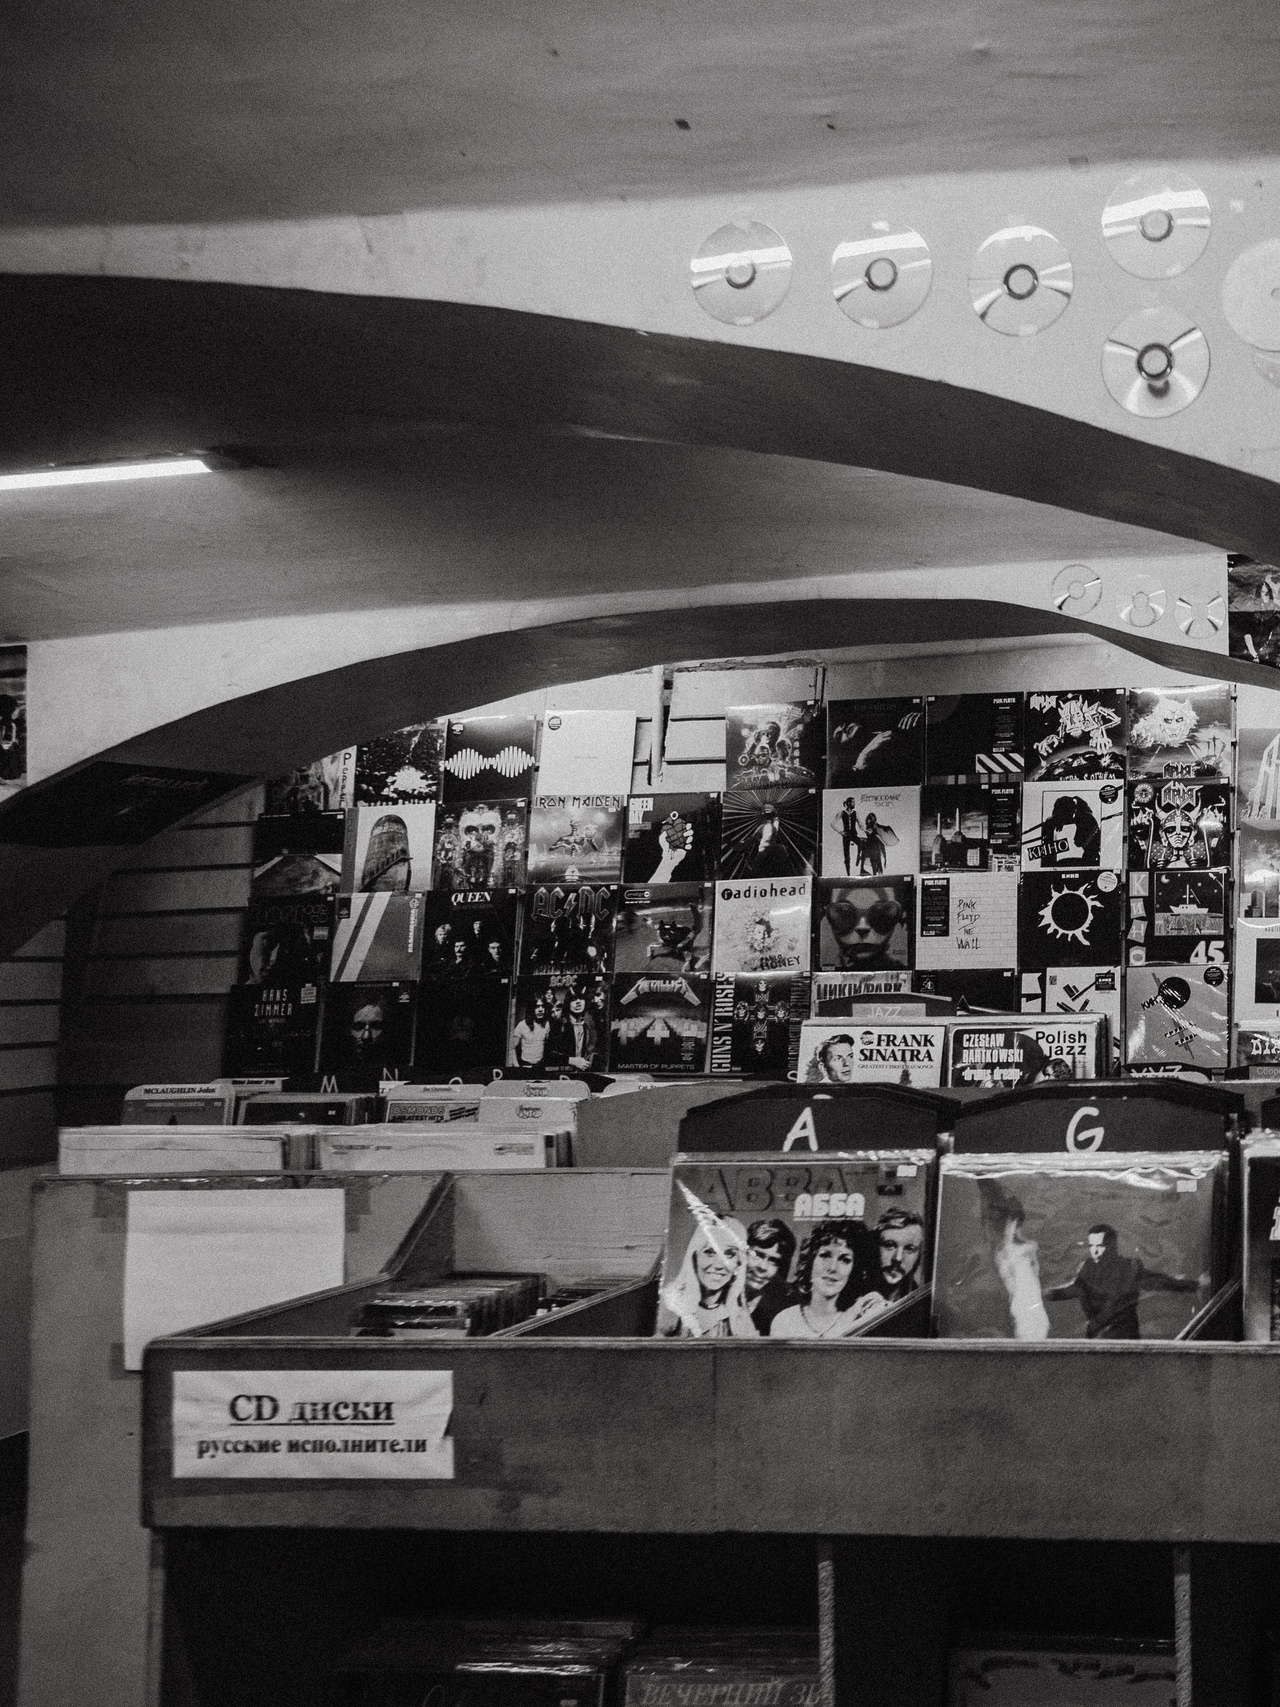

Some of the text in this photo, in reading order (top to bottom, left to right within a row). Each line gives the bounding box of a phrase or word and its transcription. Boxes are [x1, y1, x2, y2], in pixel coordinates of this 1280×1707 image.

[534, 795, 622, 809] IRON MAIDEN
[1028, 839, 1069, 861] КИНО
[451, 891, 493, 905] QUEEN
[721, 883, 806, 900] radiohead
[957, 899, 976, 910] PINK
[956, 937, 981, 950] WALL
[1189, 940, 1225, 963] 45
[760, 955, 801, 970] HONEY
[262, 989, 289, 1002] HANS
[620, 976, 702, 1006] METALLICA
[715, 972, 736, 1018] ROSES
[254, 1003, 293, 1017] ZIMMER
[867, 1006, 902, 1017] JAZZ
[876, 1034, 935, 1047] FRANK
[1036, 1031, 1087, 1044] Polish
[712, 1035, 733, 1073] GUNS
[859, 1048, 934, 1062] SINATRA
[962, 1048, 1023, 1063] BARTKOWSKI
[1048, 1045, 1087, 1058] jazz
[320, 1075, 339, 1093] M
[782, 1106, 818, 1152] A
[1066, 1106, 1105, 1152] G
[229, 1394, 395, 1423] CD диски
[197, 1438, 427, 1458] русские исполнители
